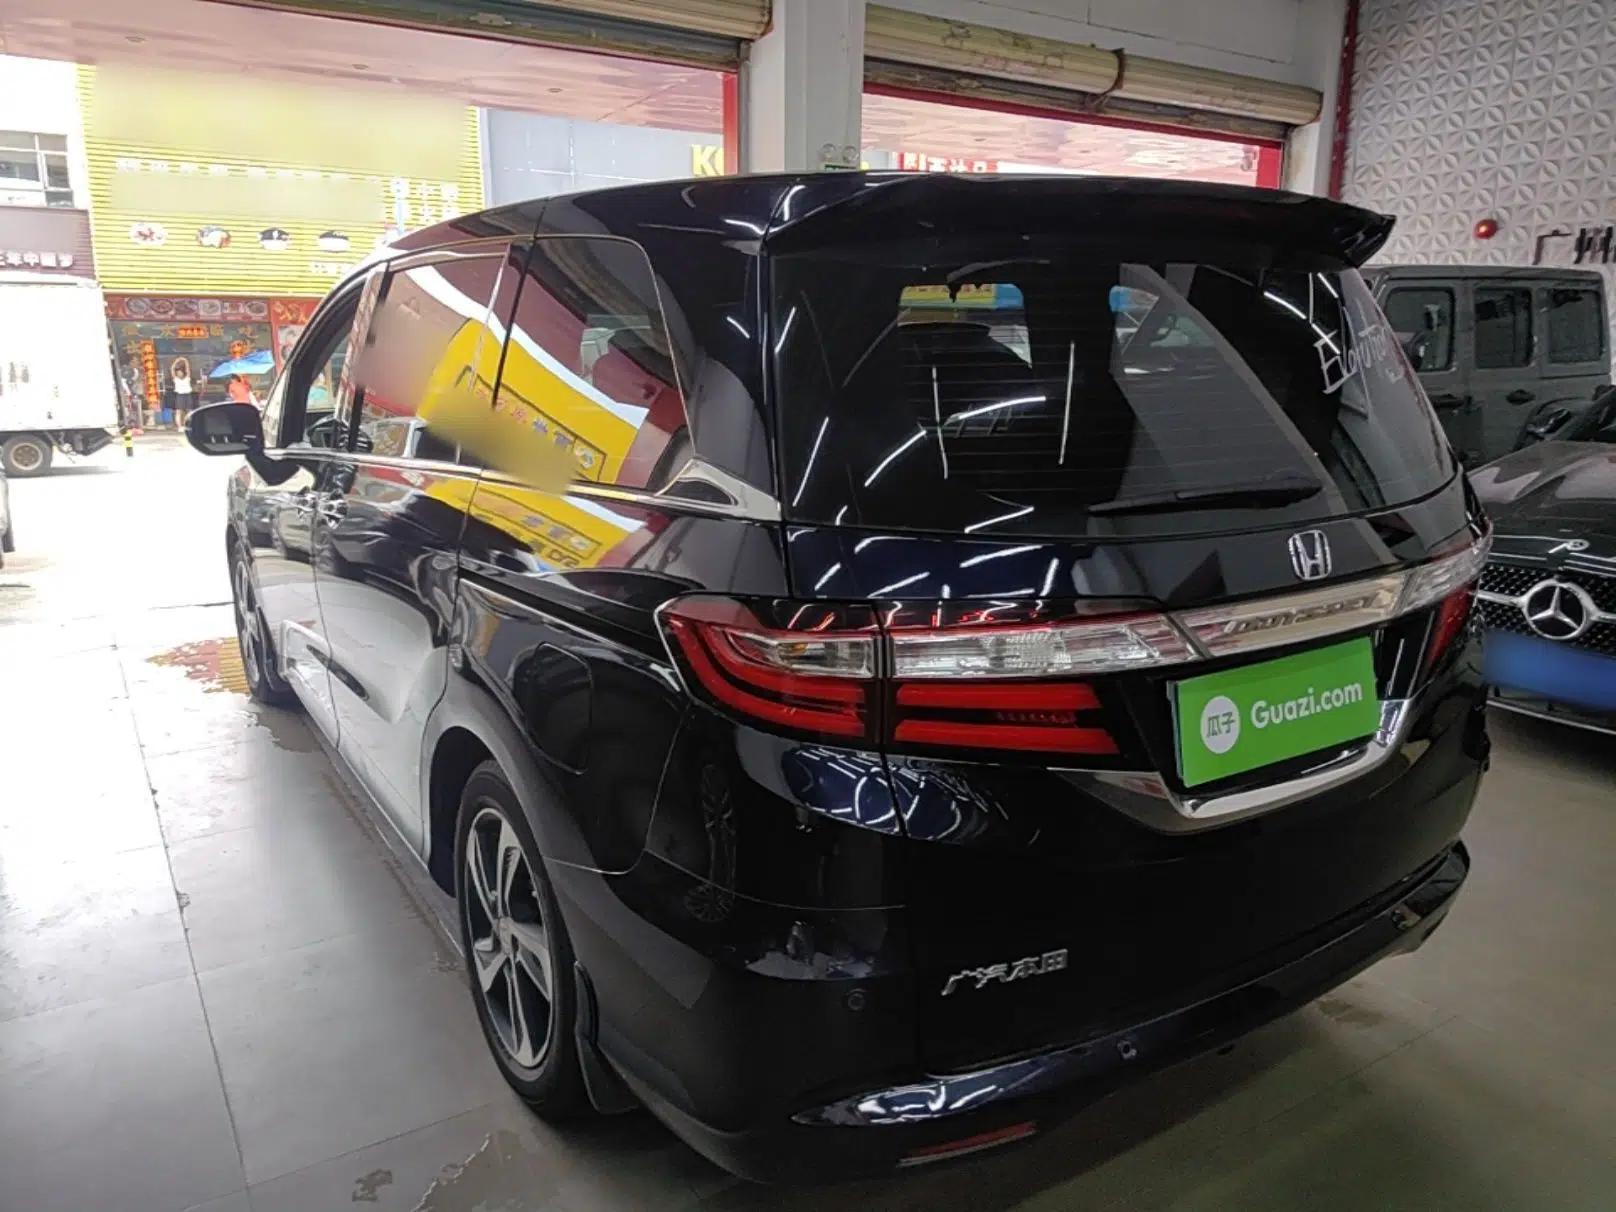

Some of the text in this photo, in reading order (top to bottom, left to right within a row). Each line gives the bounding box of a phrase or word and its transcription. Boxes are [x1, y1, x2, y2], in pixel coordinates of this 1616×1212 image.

[1206, 712, 1235, 737] 瓜子
[1251, 682, 1363, 728] Guazi.com
[941, 949, 1067, 995] 广汽本田
